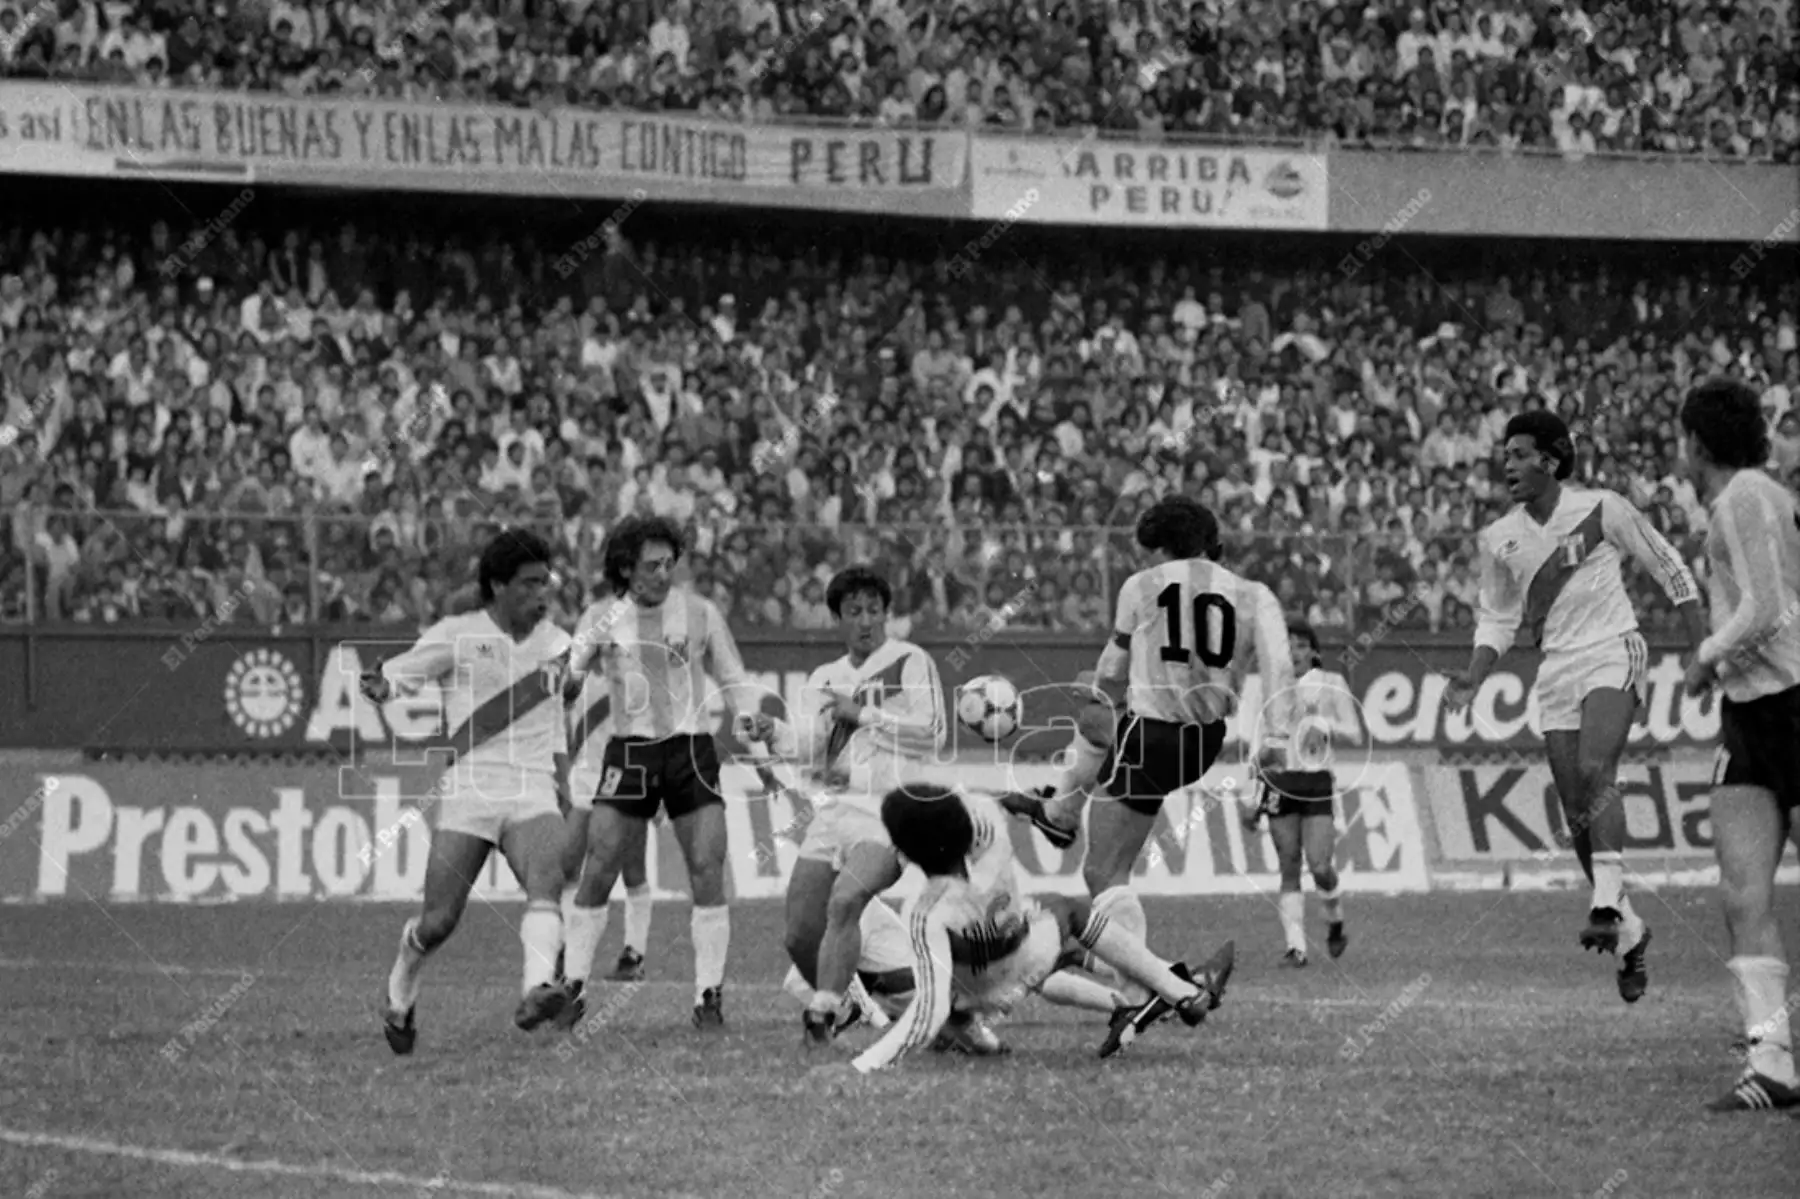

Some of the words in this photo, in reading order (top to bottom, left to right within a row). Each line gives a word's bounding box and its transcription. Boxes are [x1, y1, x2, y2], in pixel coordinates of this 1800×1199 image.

[213, 101, 342, 158] BUENAS
[353, 109, 373, 159] Y
[494, 116, 599, 167] MALAS
[621, 121, 746, 181] CONTIGO
[789, 137, 935, 185] PERU
[1157, 582, 1236, 669] 10
[36, 773, 440, 896] Prestob
